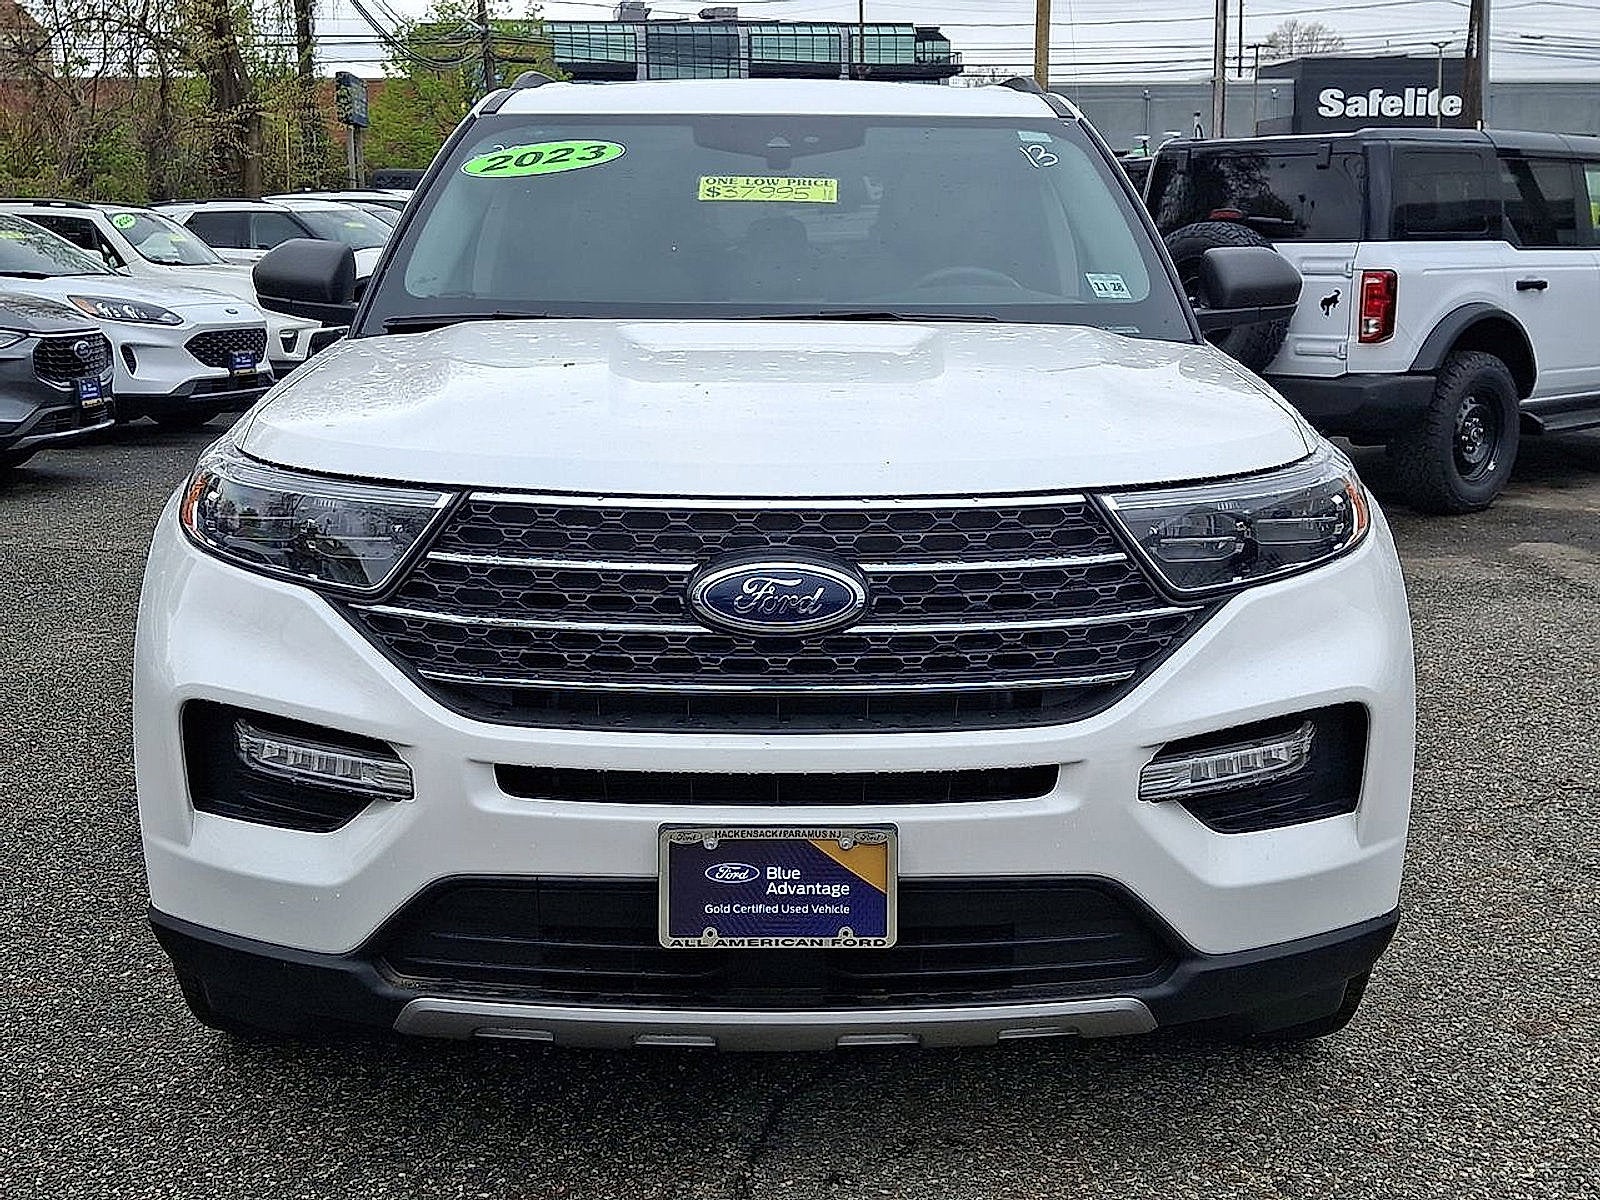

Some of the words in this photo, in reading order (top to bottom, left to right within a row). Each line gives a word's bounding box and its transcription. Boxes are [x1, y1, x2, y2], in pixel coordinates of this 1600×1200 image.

[1318, 88, 1462, 117] Safelite
[480, 145, 607, 172] 2023
[787, 179, 833, 187] PRICE
[733, 577, 825, 614] Ford
[715, 864, 750, 879] Ford
[766, 866, 801, 880] Blue
[766, 881, 850, 897] Advantage
[704, 903, 731, 914] Gold
[733, 903, 779, 914] Certified
[781, 903, 809, 914] Used
[811, 903, 850, 914] Vehicle
[670, 938, 712, 948] ALL
[713, 938, 824, 948] AMERICAN
[831, 938, 887, 948] FORD
